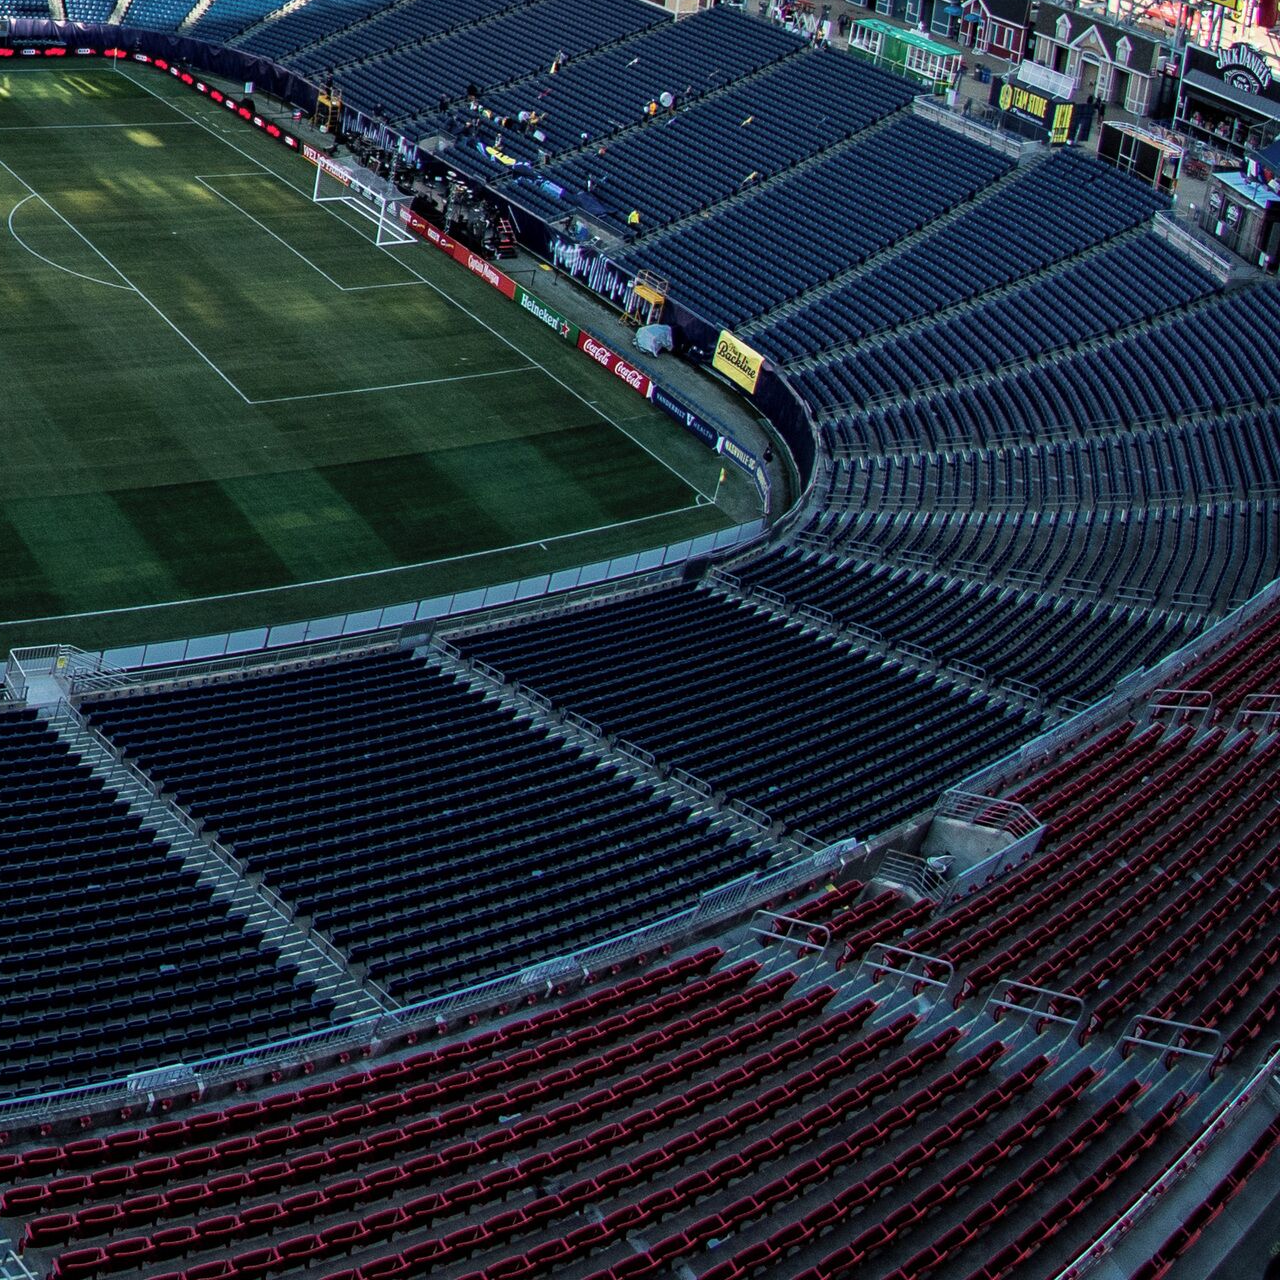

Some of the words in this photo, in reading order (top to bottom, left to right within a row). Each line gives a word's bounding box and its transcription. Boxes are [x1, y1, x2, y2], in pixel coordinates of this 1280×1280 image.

[1216, 47, 1239, 69] JACK
[520, 293, 559, 330] Heineken
[583, 339, 611, 366] Coca-Cola
[718, 340, 756, 379] Backline
[614, 361, 642, 389] Coca-Cola
[656, 390, 686, 420] VANDERBILT
[693, 421, 714, 440] HEALTH
